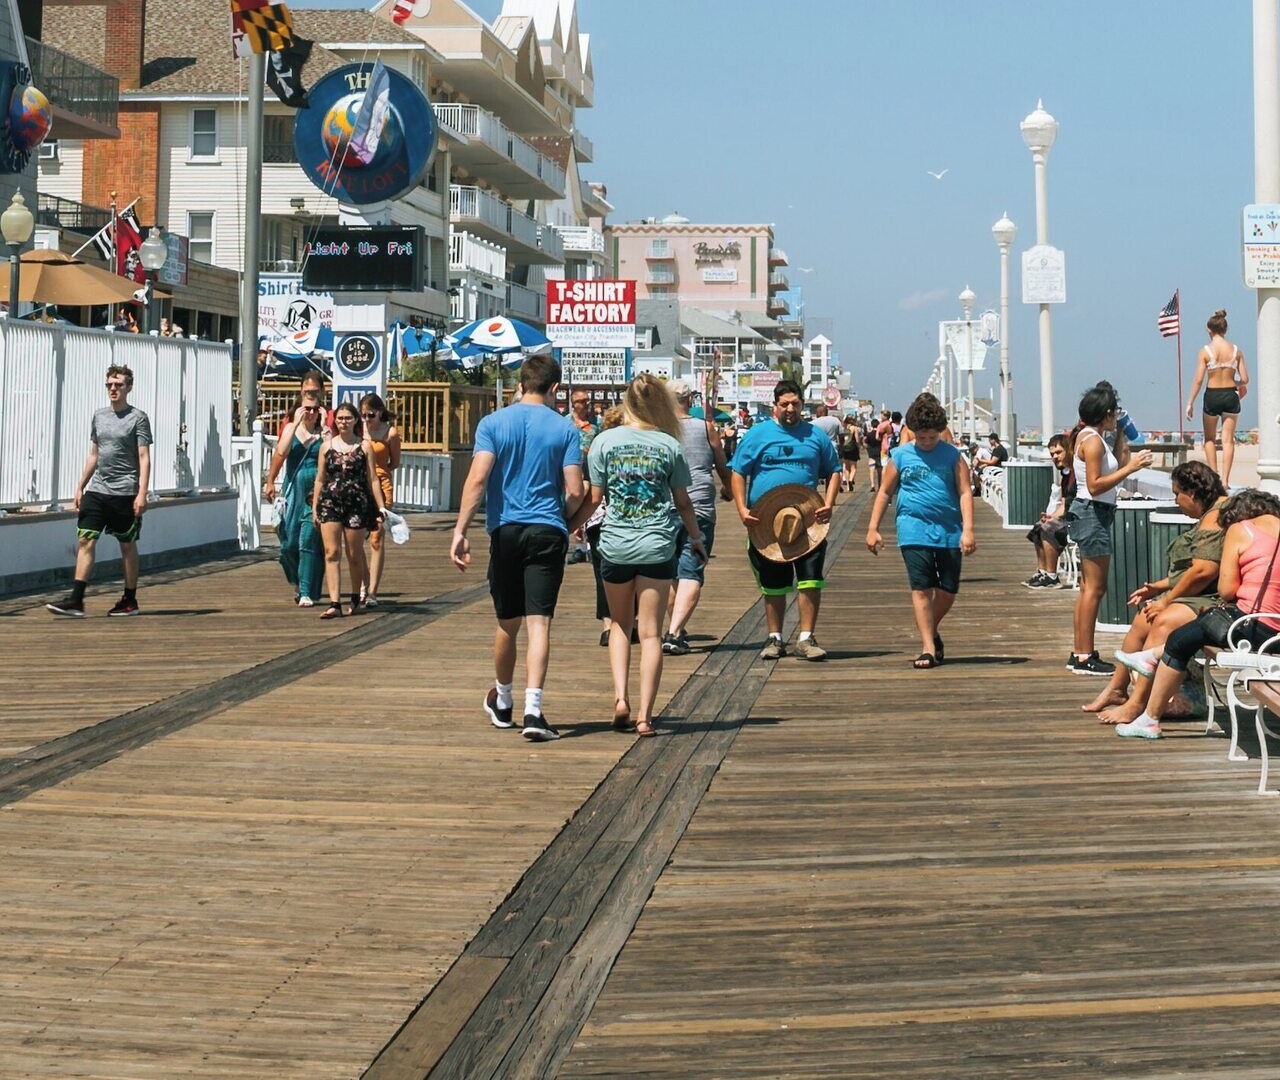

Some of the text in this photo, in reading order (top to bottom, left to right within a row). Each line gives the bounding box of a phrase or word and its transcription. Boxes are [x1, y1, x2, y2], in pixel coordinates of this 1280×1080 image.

[344, 72, 371, 90] TH
[306, 242, 412, 255] Light Up Fri
[556, 282, 626, 301] T-SHIRT
[550, 303, 631, 322] FACTORY
[348, 340, 366, 351] Life
